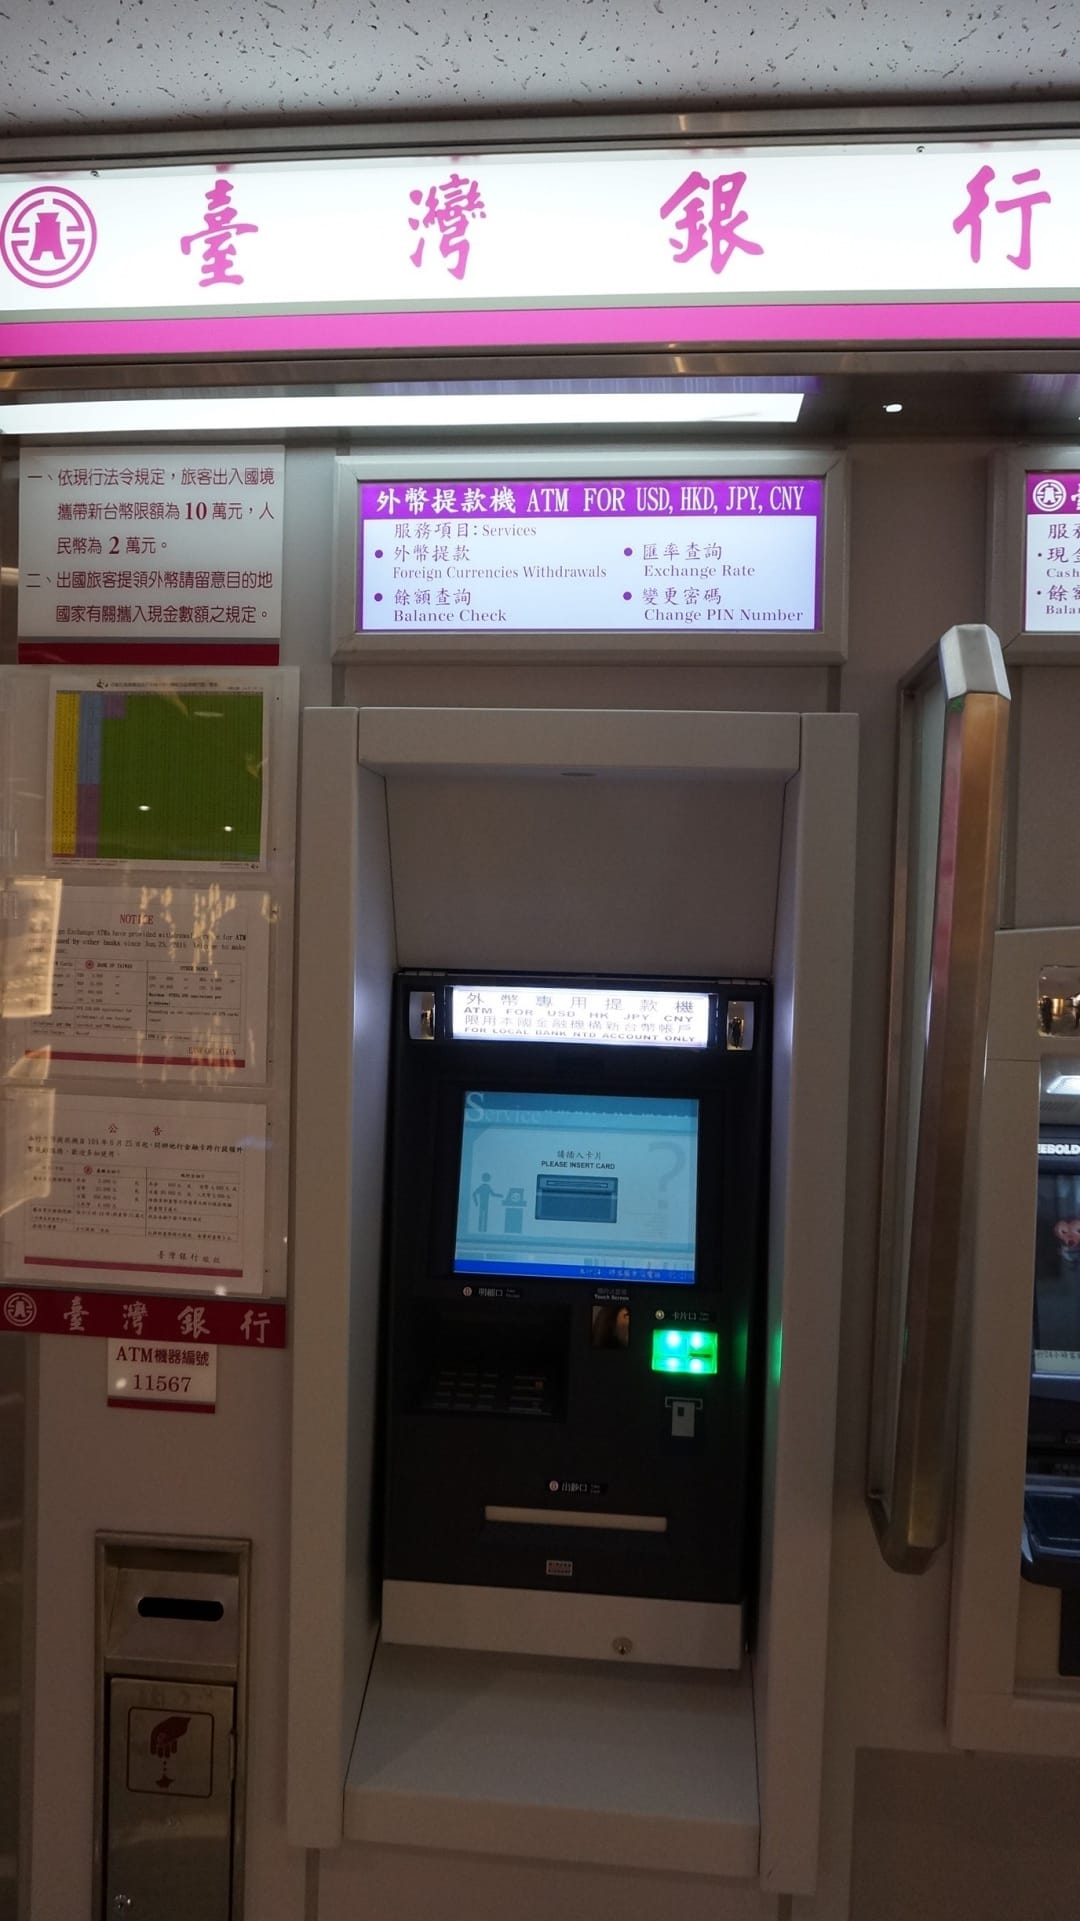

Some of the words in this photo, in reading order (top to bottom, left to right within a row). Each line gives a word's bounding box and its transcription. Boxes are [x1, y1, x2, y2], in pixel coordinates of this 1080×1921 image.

[181, 165, 1052, 288] 臺灣銀行
[376, 486, 517, 515] 外幣提款機
[527, 488, 570, 512] ATM
[583, 487, 626, 512] FOR
[636, 487, 673, 514] USD,
[680, 486, 718, 514] HKD,
[726, 486, 763, 513] JPY,
[769, 486, 805, 511] CNY
[184, 502, 207, 520] 10
[482, 523, 537, 537] Services
[57, 537, 102, 555] 民幣為
[109, 536, 120, 555] 2
[126, 537, 167, 554] 萬元。
[394, 545, 470, 563] 外幣提款
[643, 542, 723, 561] 匯率查詢
[393, 566, 442, 581] Foreign
[447, 567, 518, 579] Currencies
[523, 565, 607, 579] Withdrawals
[644, 564, 716, 579] Exchange
[722, 565, 756, 578] Rate
[394, 588, 471, 606] 餘額查詢
[643, 587, 721, 605] 變更密碼
[394, 609, 454, 622] Balance
[459, 608, 507, 622] Check
[644, 608, 701, 623] Change
[707, 608, 734, 621] PIN
[740, 608, 803, 622] Number
[120, 914, 154, 926] NOTICE
[467, 992, 695, 1013] 外幣專用提款機
[663, 1015, 694, 1023] CNY
[541, 1160, 568, 1168] PLEASE
[63, 1296, 271, 1344] 臺灣銀行
[116, 1345, 209, 1367] ATM機器編號
[133, 1374, 191, 1393] 11567
